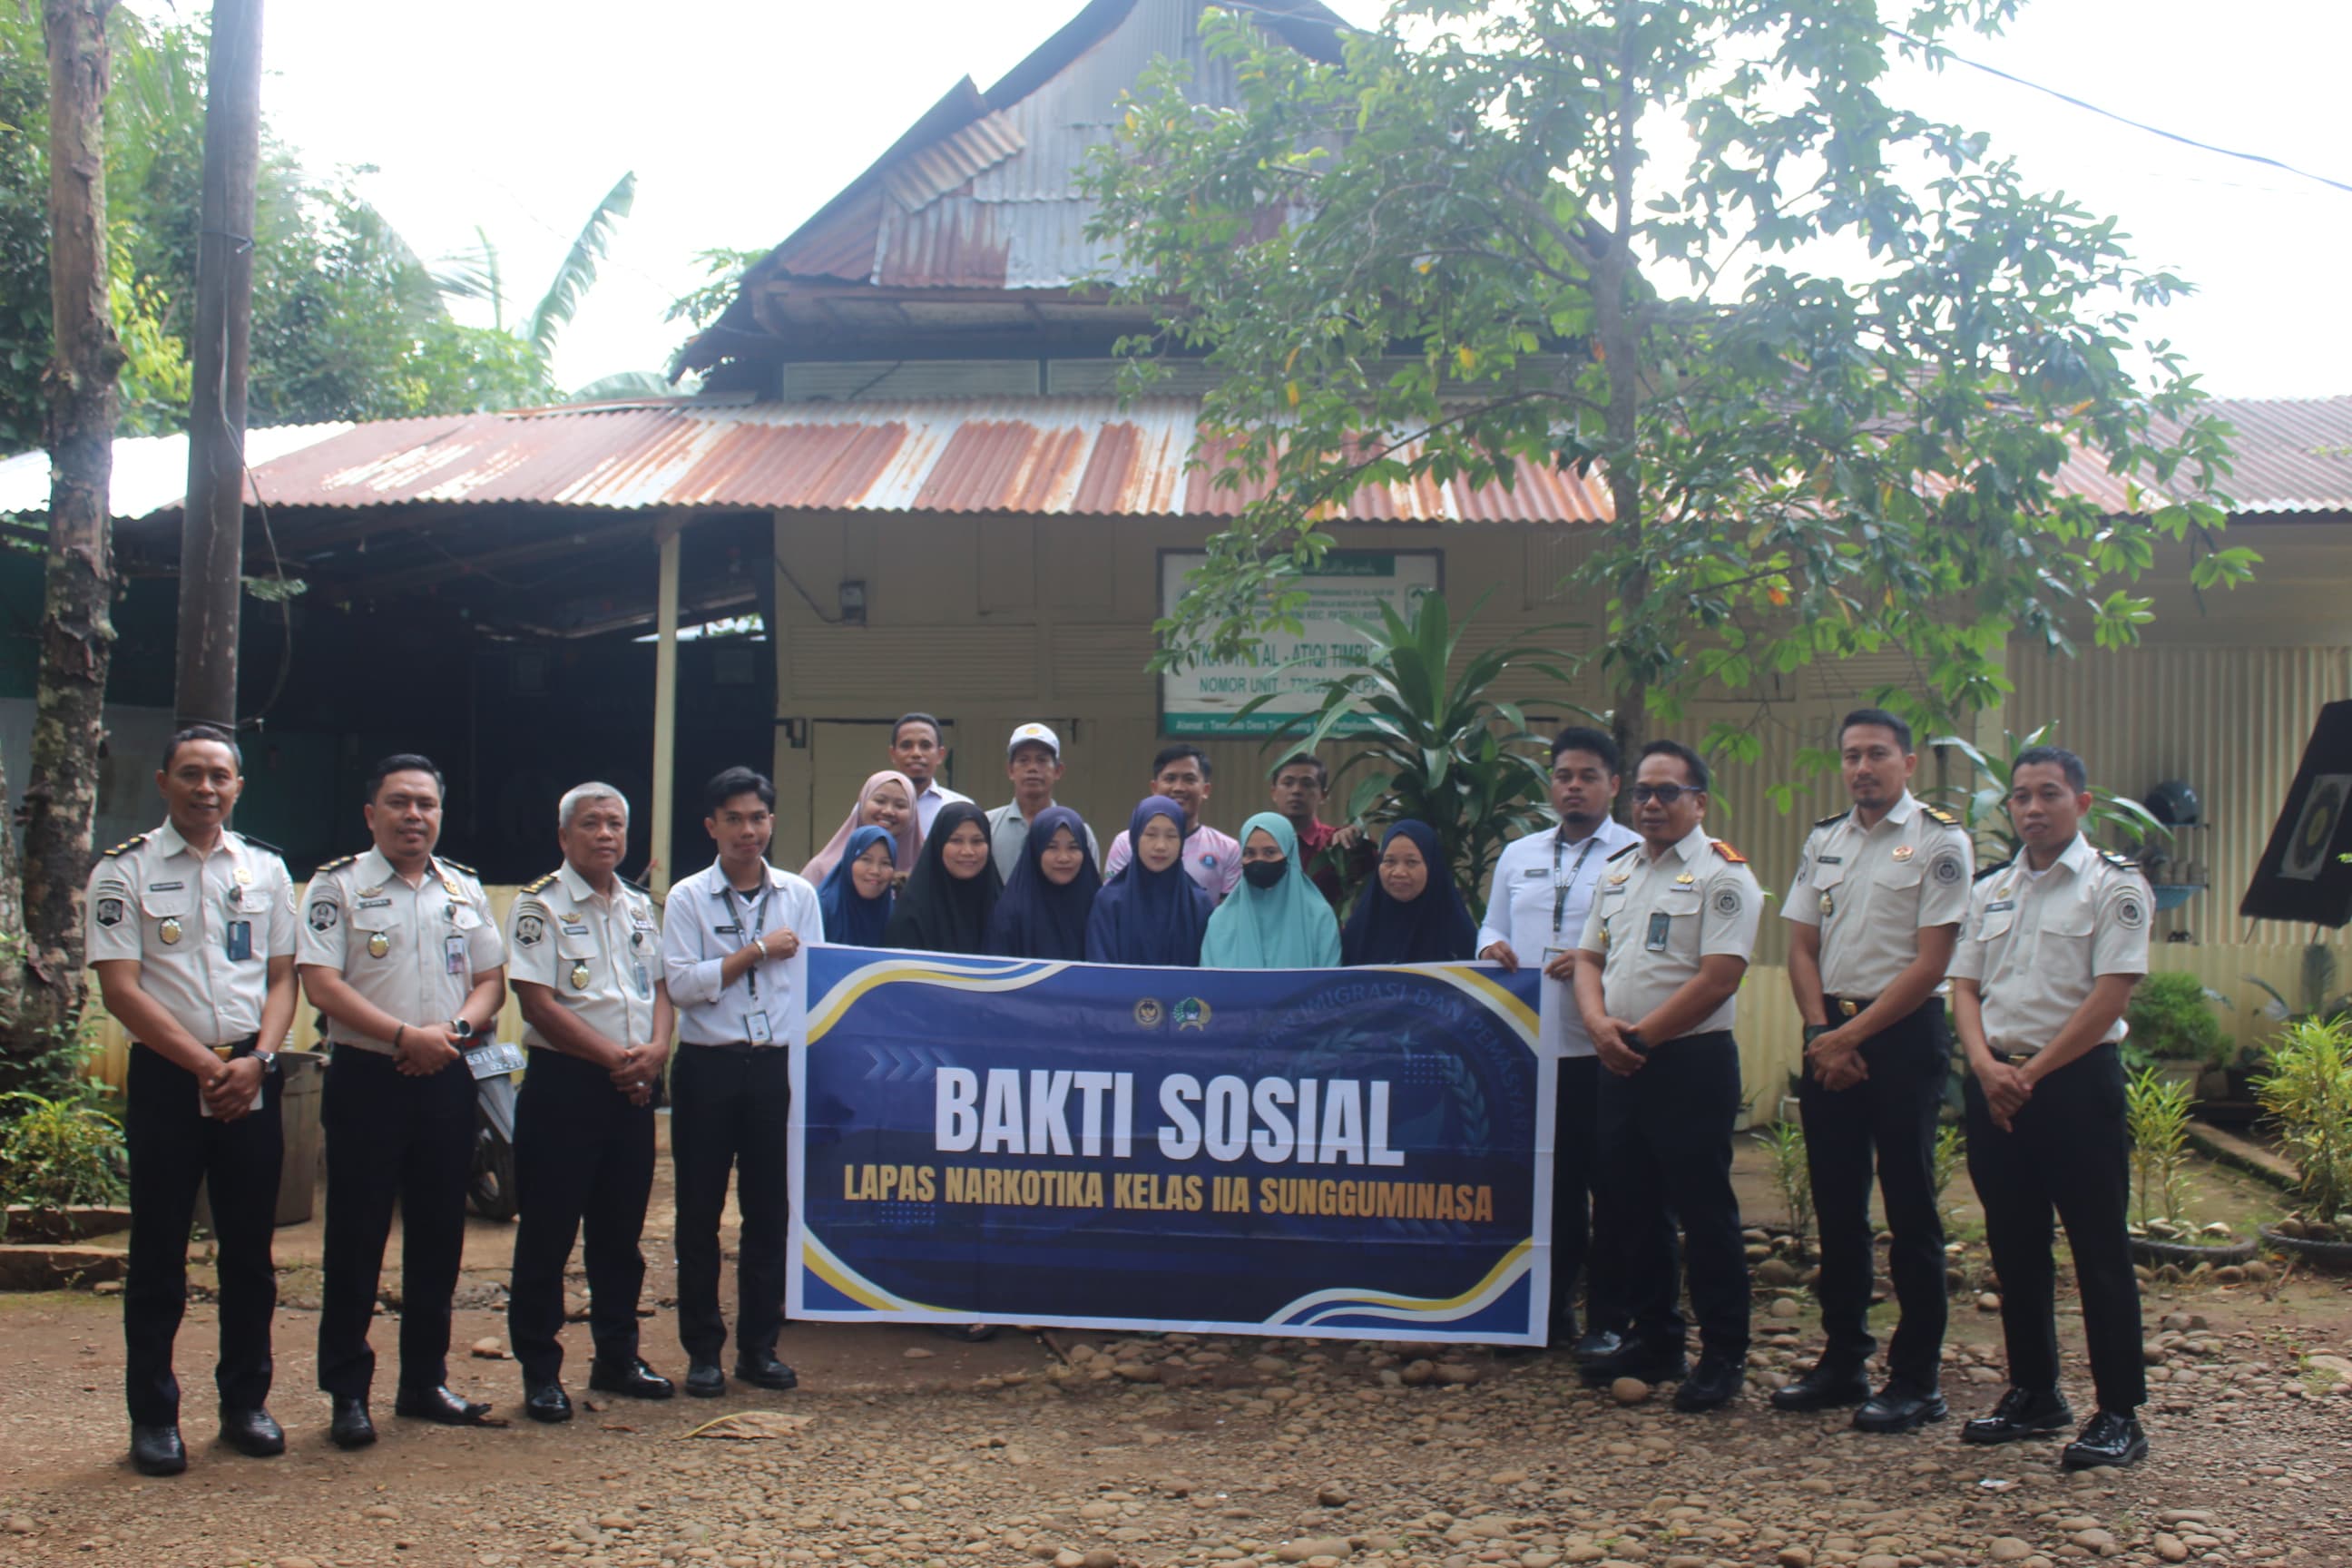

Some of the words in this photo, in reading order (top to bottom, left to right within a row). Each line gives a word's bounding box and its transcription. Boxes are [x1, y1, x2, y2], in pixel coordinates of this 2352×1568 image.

[1200, 677, 1247, 692] NOMOR
[1250, 677, 1278, 693] UNIT
[936, 1066, 1133, 1158] BAKTI
[1158, 1073, 1406, 1167] SOSIAL
[844, 1164, 936, 1201] LAPAS
[945, 1167, 1103, 1208] NARKOTIKA
[1113, 1173, 1203, 1211] KELAS
[1212, 1176, 1250, 1213] IIA
[1259, 1178, 1493, 1222] SUNGGUMINASA
